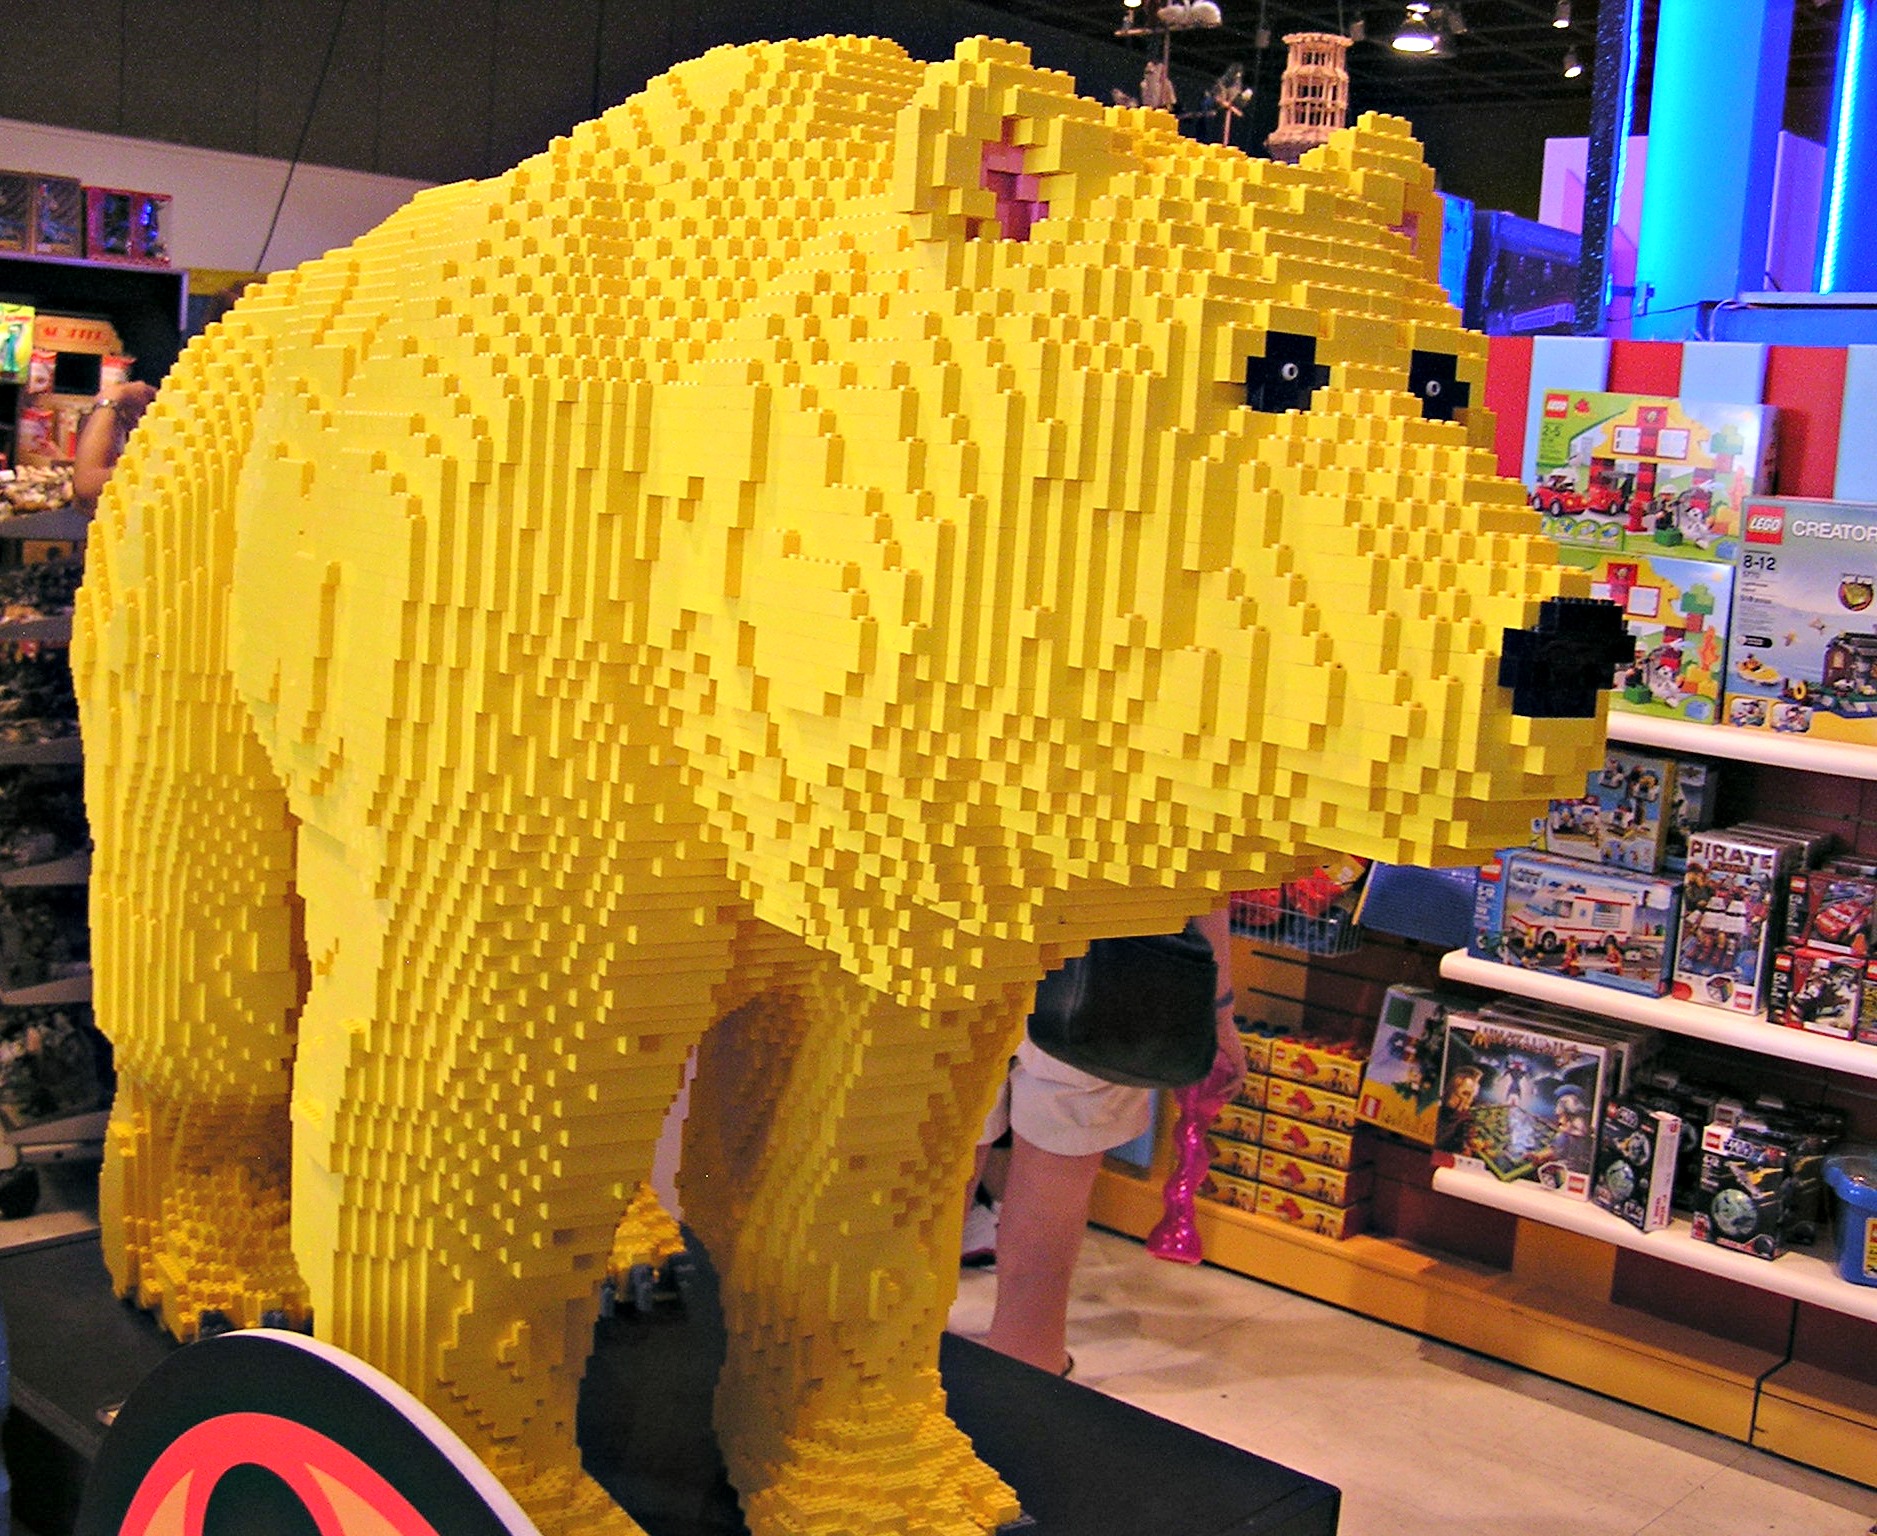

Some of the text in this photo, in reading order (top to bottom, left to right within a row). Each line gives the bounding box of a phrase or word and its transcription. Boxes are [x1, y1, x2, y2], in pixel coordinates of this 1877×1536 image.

[1748, 515, 1782, 532] LEGO
[1791, 519, 1877, 542] CREATOR
[1743, 554, 1776, 571] 8-12
[1691, 840, 1772, 870] PIRATE
